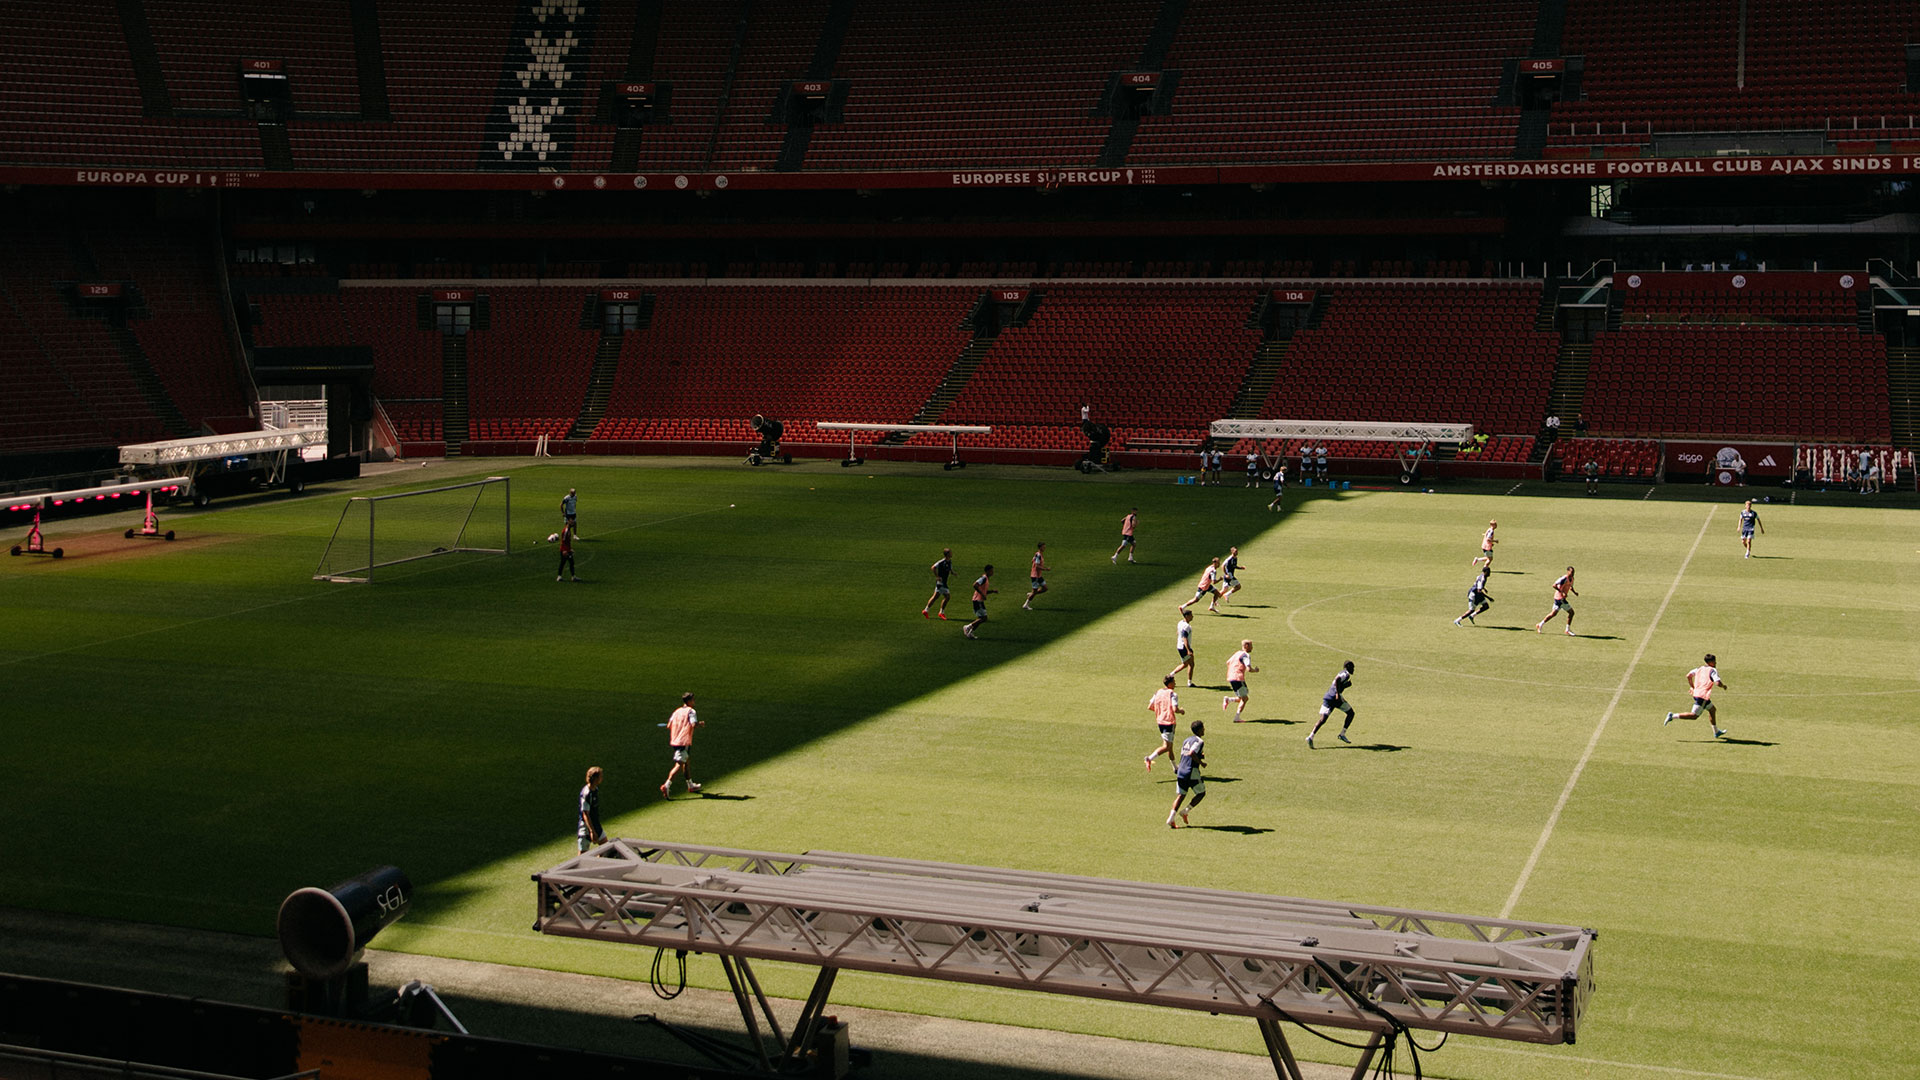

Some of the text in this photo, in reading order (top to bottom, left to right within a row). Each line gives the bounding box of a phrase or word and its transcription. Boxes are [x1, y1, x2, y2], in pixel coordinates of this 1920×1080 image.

[253, 61, 270, 69] 401
[1532, 61, 1553, 70] 405
[1132, 75, 1151, 83] 404
[626, 85, 645, 93] 402
[803, 84, 822, 92] 403
[1433, 162, 1597, 177] AMSTERDAMSCHE
[1607, 160, 1705, 175] FOOTBALL
[1712, 159, 1763, 172] CLUB
[1769, 158, 1825, 174] AJAX
[1832, 157, 1892, 171] SINDS
[76, 171, 201, 185] EUROPA CUP I
[952, 171, 1121, 185] EUROPESE SUPERCUP
[90, 286, 108, 294] 129
[446, 292, 461, 300] 101
[612, 291, 629, 299] 102
[1002, 292, 1019, 300] 103
[1285, 292, 1304, 300] 104
[1677, 452, 1703, 464] ziggo
[377, 885, 408, 919] SGL
